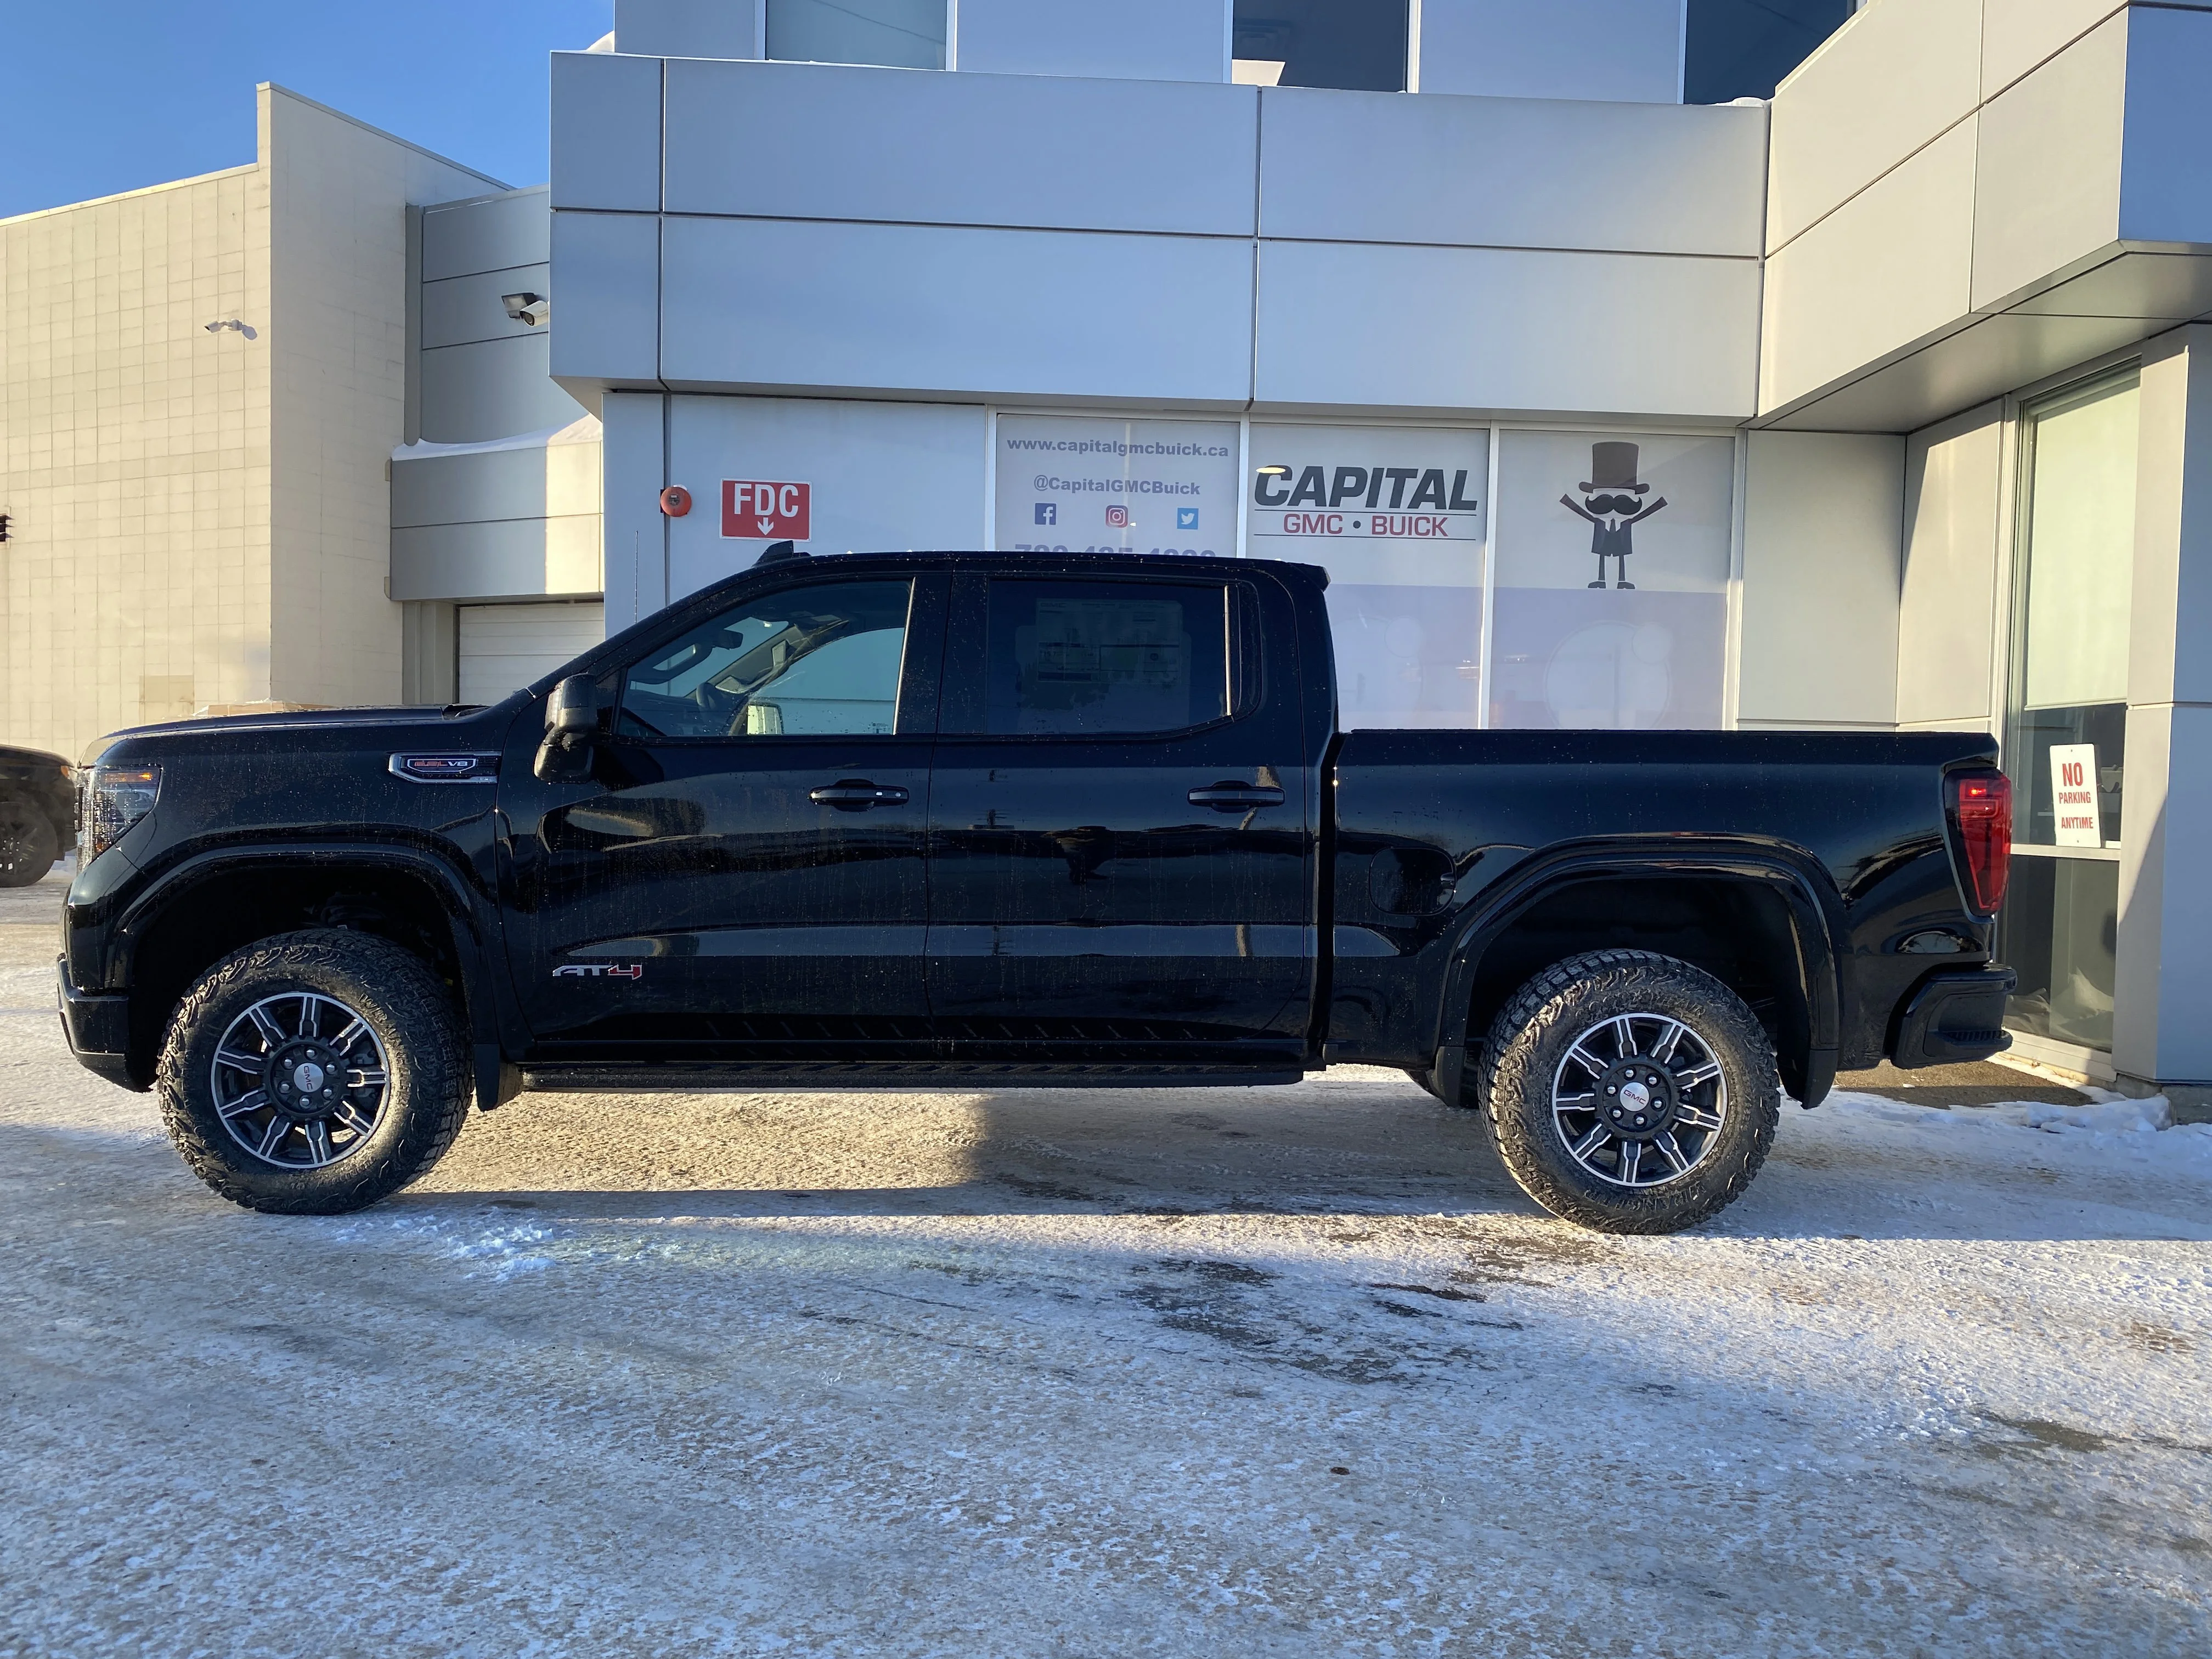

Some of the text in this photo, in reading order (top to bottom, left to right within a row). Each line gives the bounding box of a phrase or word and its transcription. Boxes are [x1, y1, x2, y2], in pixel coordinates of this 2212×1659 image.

[1007, 439, 1228, 456] www.capitalgmcbuick.ca
[1034, 475, 1200, 495] @CapitalGMCBuick
[1254, 465, 1478, 510] CAPITAL
[734, 483, 799, 517] FDC
[1284, 514, 1448, 537] GMC BUICK
[2062, 762, 2084, 787] NO
[2058, 792, 2091, 804] PARKING
[2061, 817, 2094, 829] ANYTIME
[552, 964, 642, 980] AT4
[303, 1065, 313, 1090] GMC
[1623, 1089, 1646, 1105] GMC
